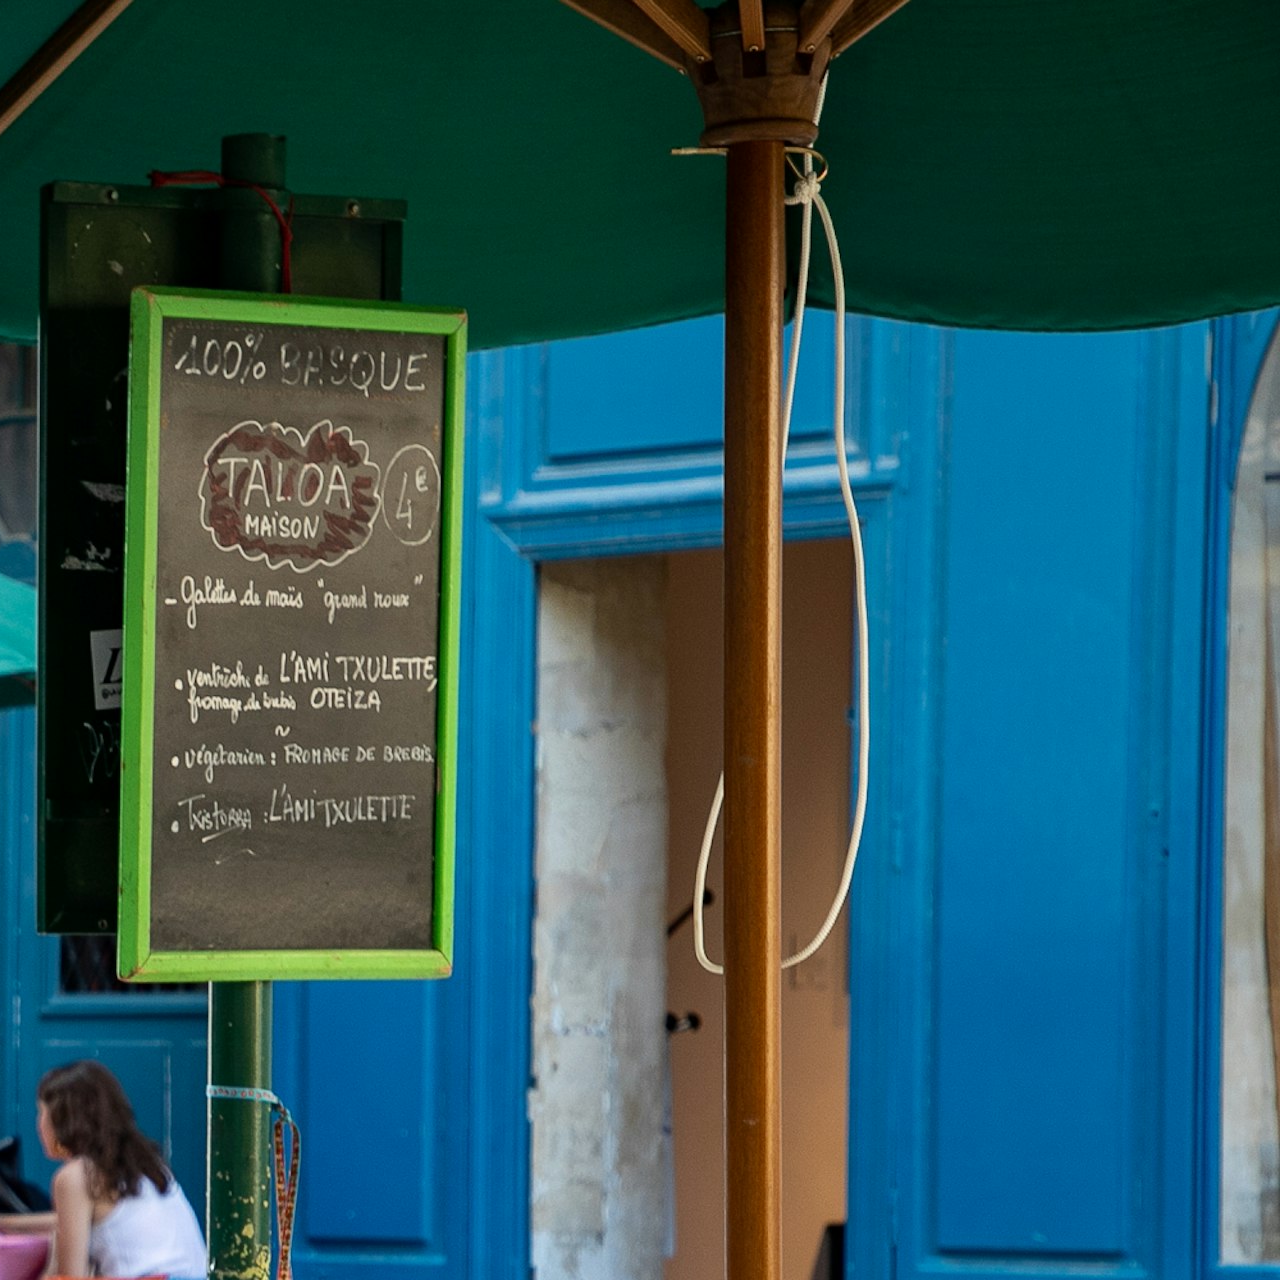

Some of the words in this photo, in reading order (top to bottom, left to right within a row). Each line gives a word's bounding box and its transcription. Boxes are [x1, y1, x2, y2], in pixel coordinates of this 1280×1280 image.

[175, 334, 267, 385] 100%
[217, 457, 352, 510] TALOA
[240, 579, 262, 607] de
[254, 664, 270, 686] de
[187, 685, 242, 724] fromage
[284, 743, 351, 765] FROMAGE
[355, 745, 376, 763] DE
[316, 794, 416, 829] TXULETTE
